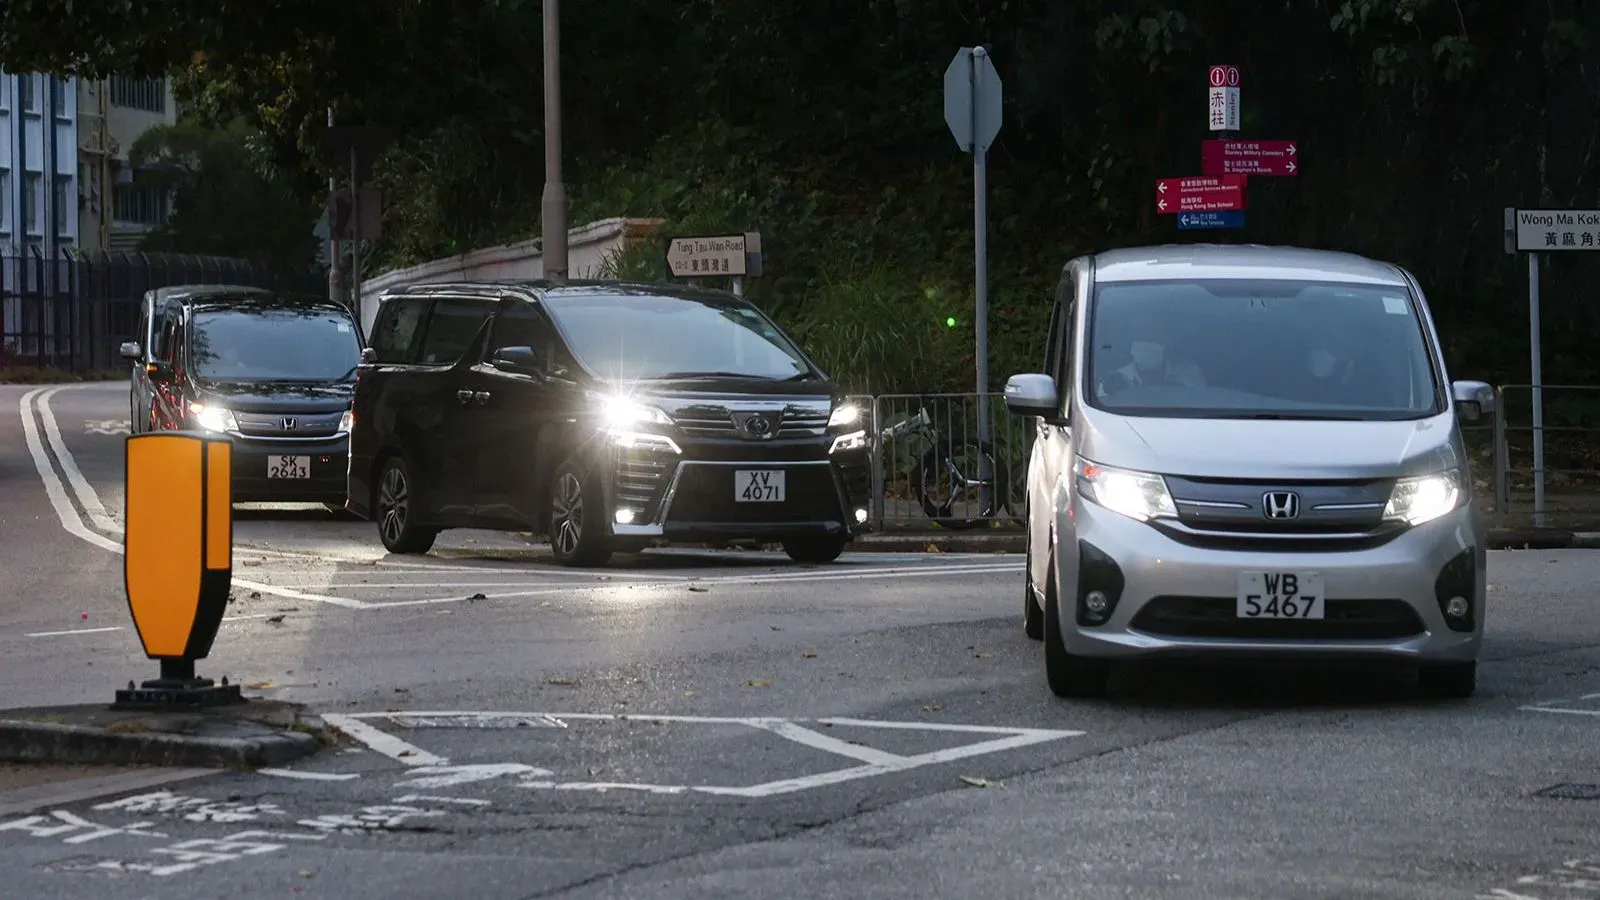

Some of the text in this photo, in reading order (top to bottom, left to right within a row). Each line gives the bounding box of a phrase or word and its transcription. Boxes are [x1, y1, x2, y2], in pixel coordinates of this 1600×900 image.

[1211, 91, 1224, 125] 赤柱
[1520, 213, 1600, 227] Wong Ma Kok
[1545, 231, 1600, 247] 黃麻角
[676, 239, 743, 255] Tung Tau Wan Road
[281, 455, 297, 467] SK
[271, 466, 306, 478] 2643
[750, 472, 770, 486] XV
[742, 486, 779, 500] 4071
[1263, 573, 1298, 595] WB
[1245, 595, 1316, 617] 5467
